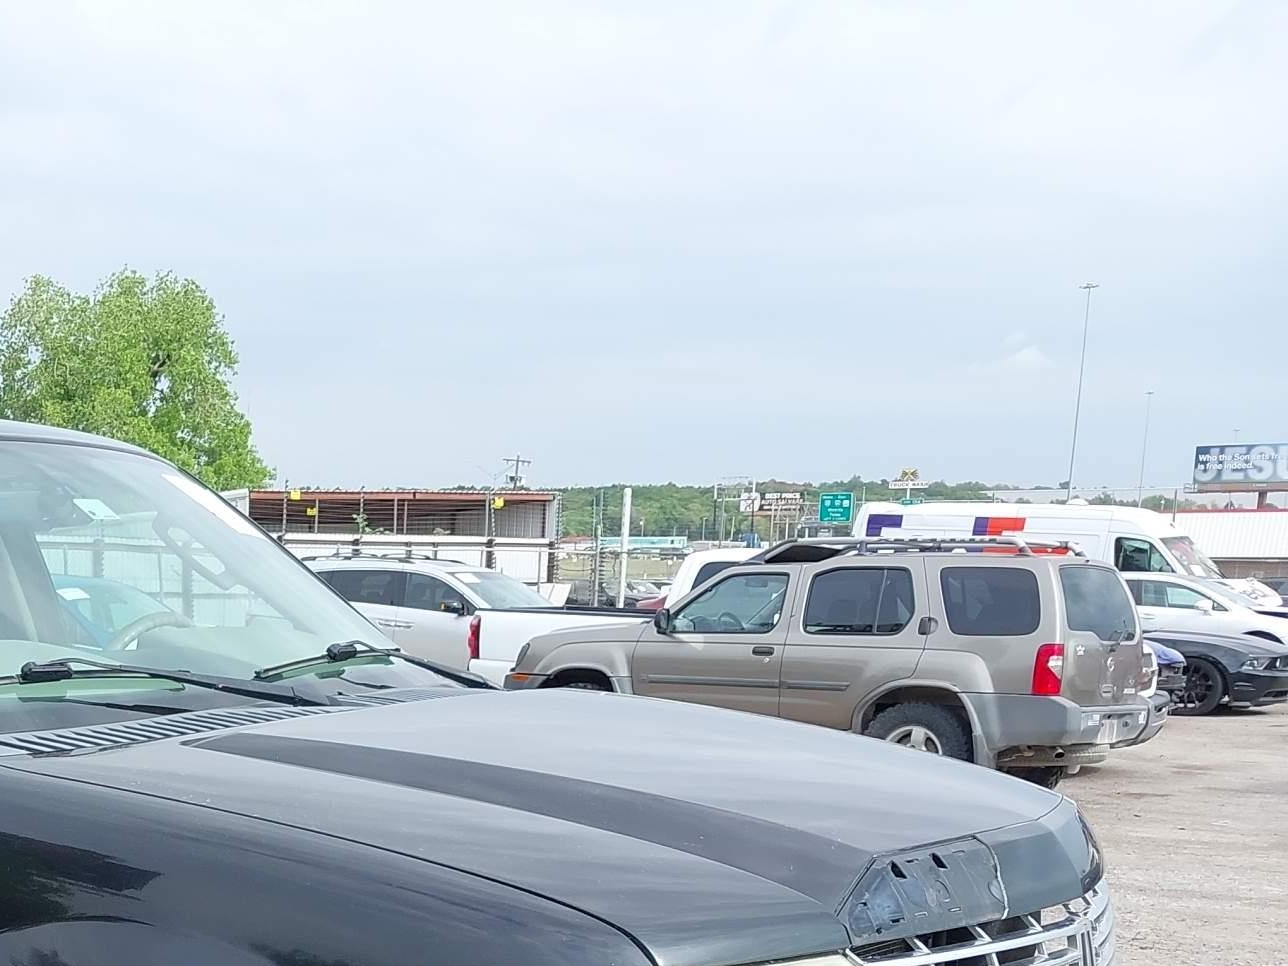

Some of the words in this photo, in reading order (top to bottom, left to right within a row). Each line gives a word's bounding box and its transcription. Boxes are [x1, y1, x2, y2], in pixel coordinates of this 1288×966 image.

[1198, 454, 1217, 462] Who
[1234, 453, 1250, 461] Son
[1206, 462, 1223, 470] free
